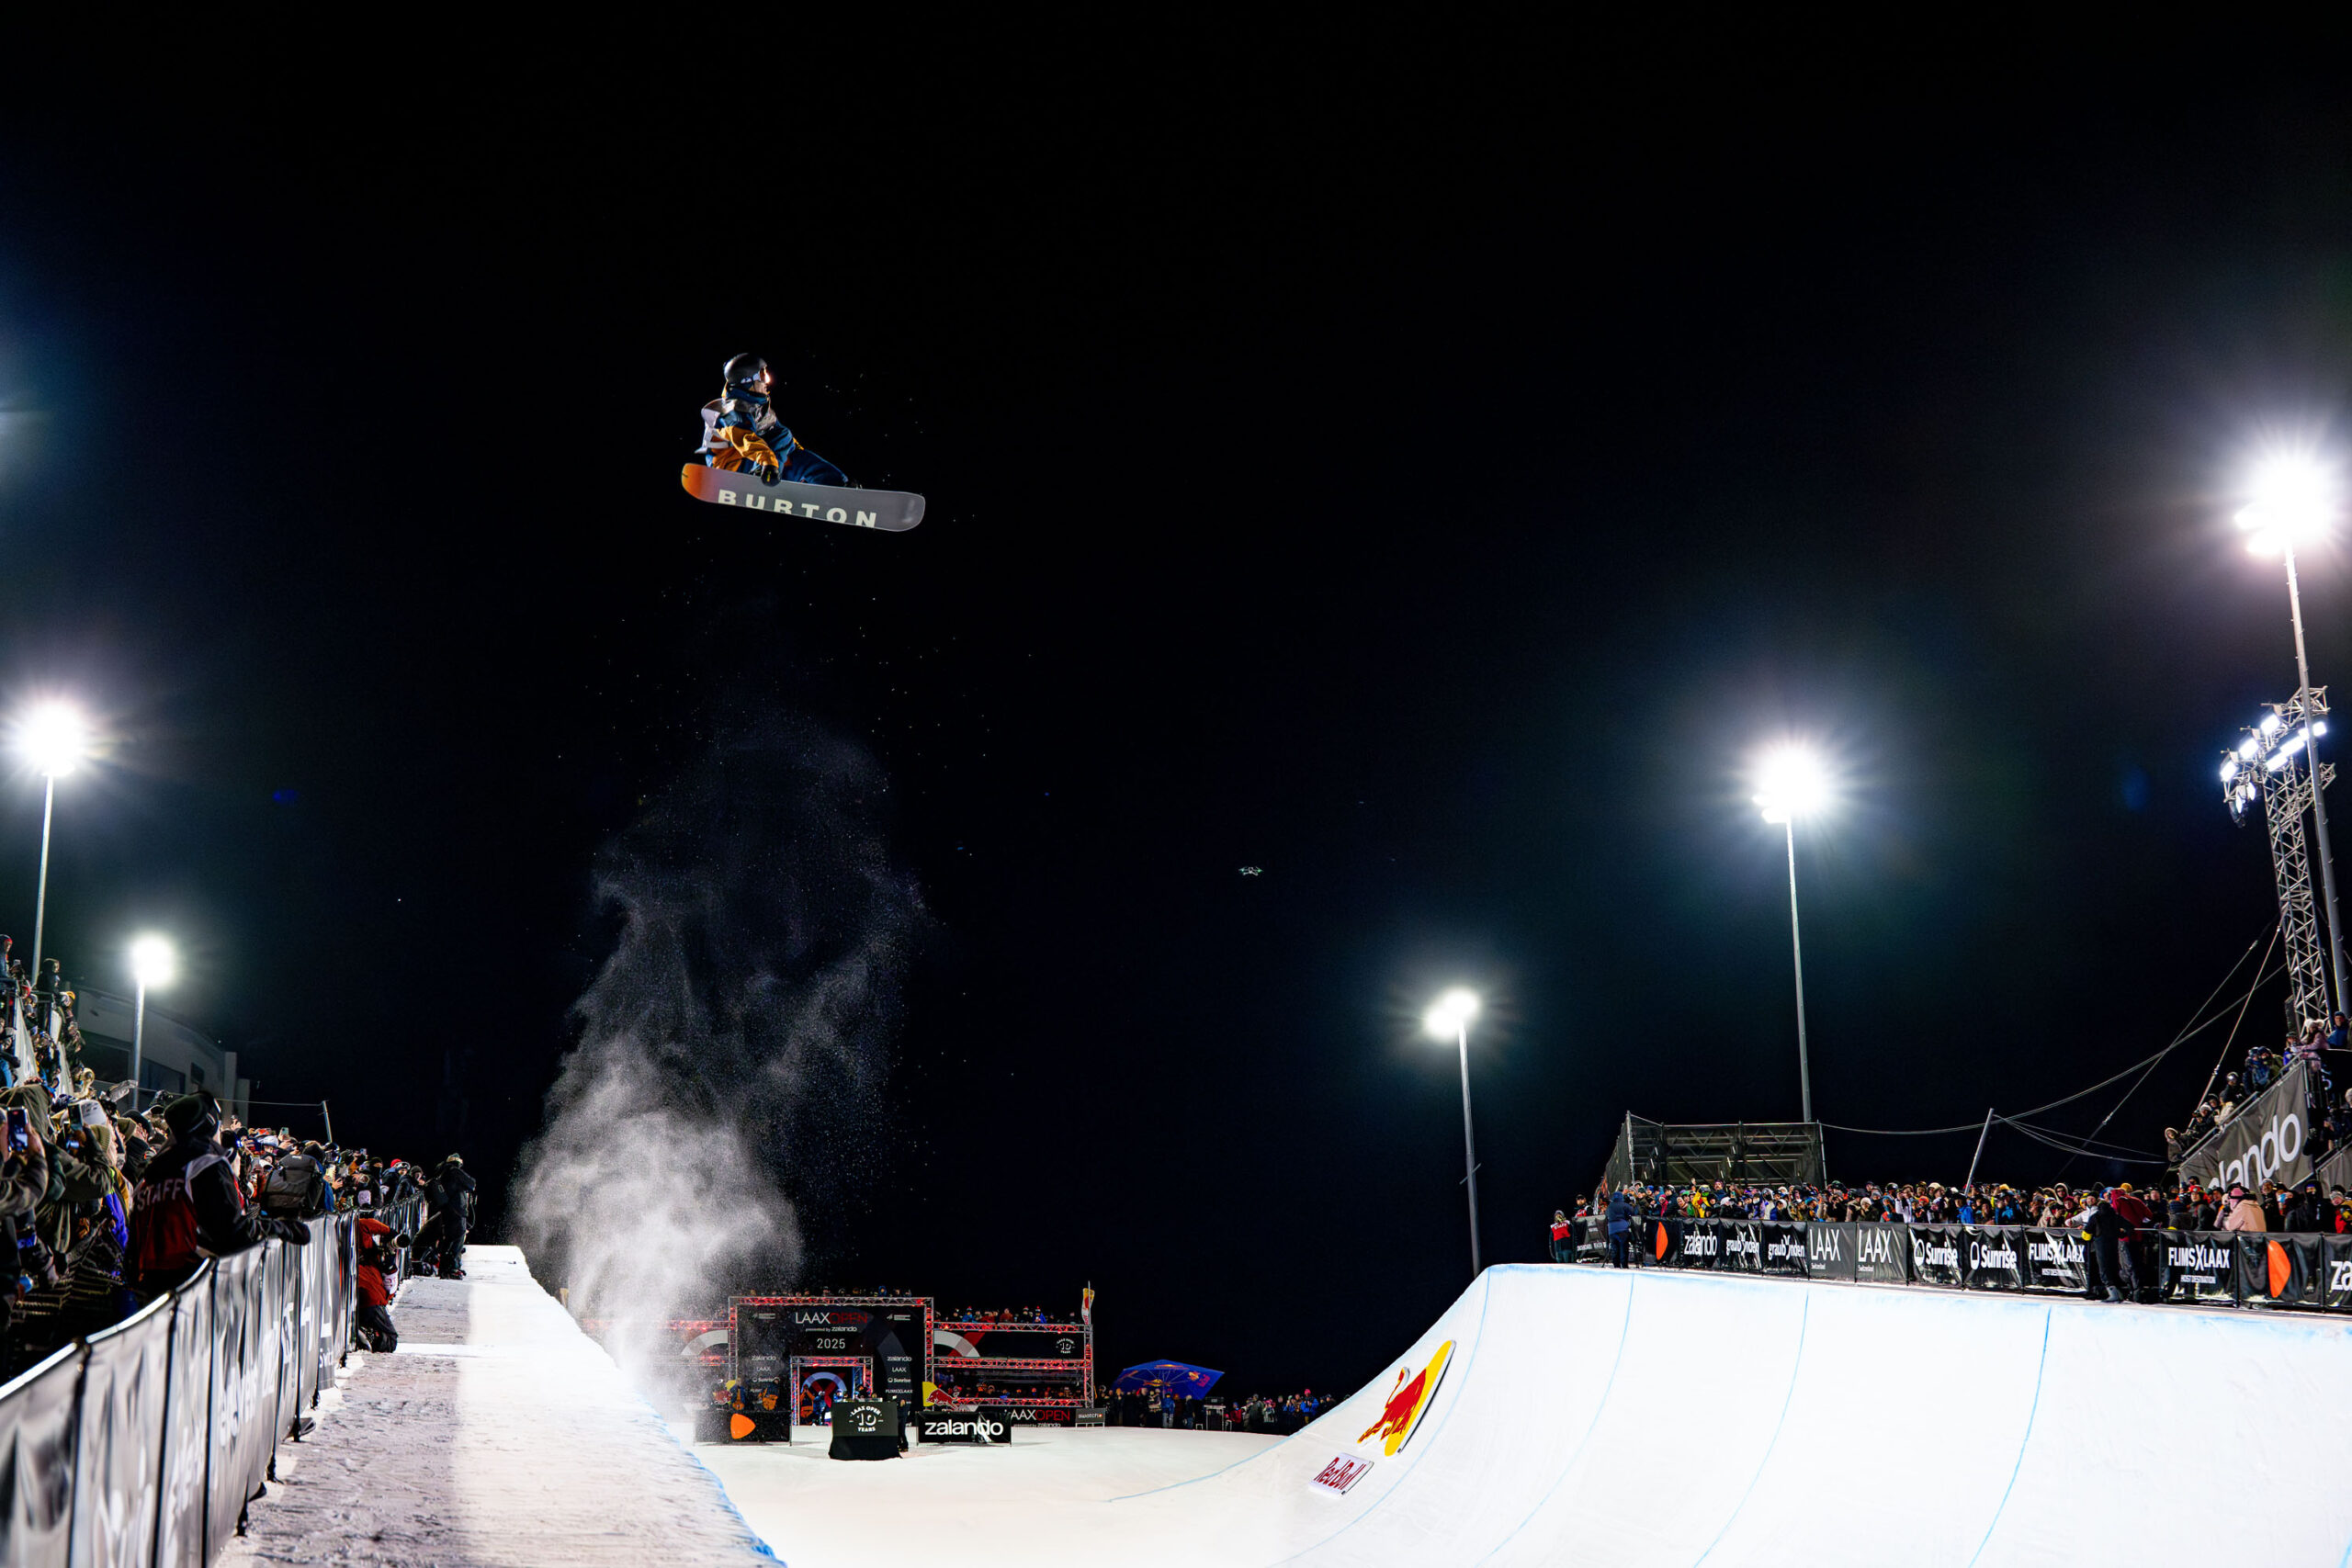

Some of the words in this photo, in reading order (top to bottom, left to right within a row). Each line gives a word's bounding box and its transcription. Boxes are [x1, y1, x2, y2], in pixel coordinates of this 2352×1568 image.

[718, 489, 876, 528] BURTON
[137, 1178, 185, 1211] STAFF
[1684, 1231, 1717, 1257] zalando
[1809, 1227, 1841, 1261] LAAX
[1858, 1228, 1892, 1264] LAAX
[1926, 1241, 1958, 1267] Sunrise
[1981, 1244, 2017, 1269] Sunrise
[817, 1338, 846, 1349] 2025
[851, 1405, 865, 1416] LAAX
[865, 1405, 881, 1416] OPEN
[924, 1419, 1004, 1436] zalando
